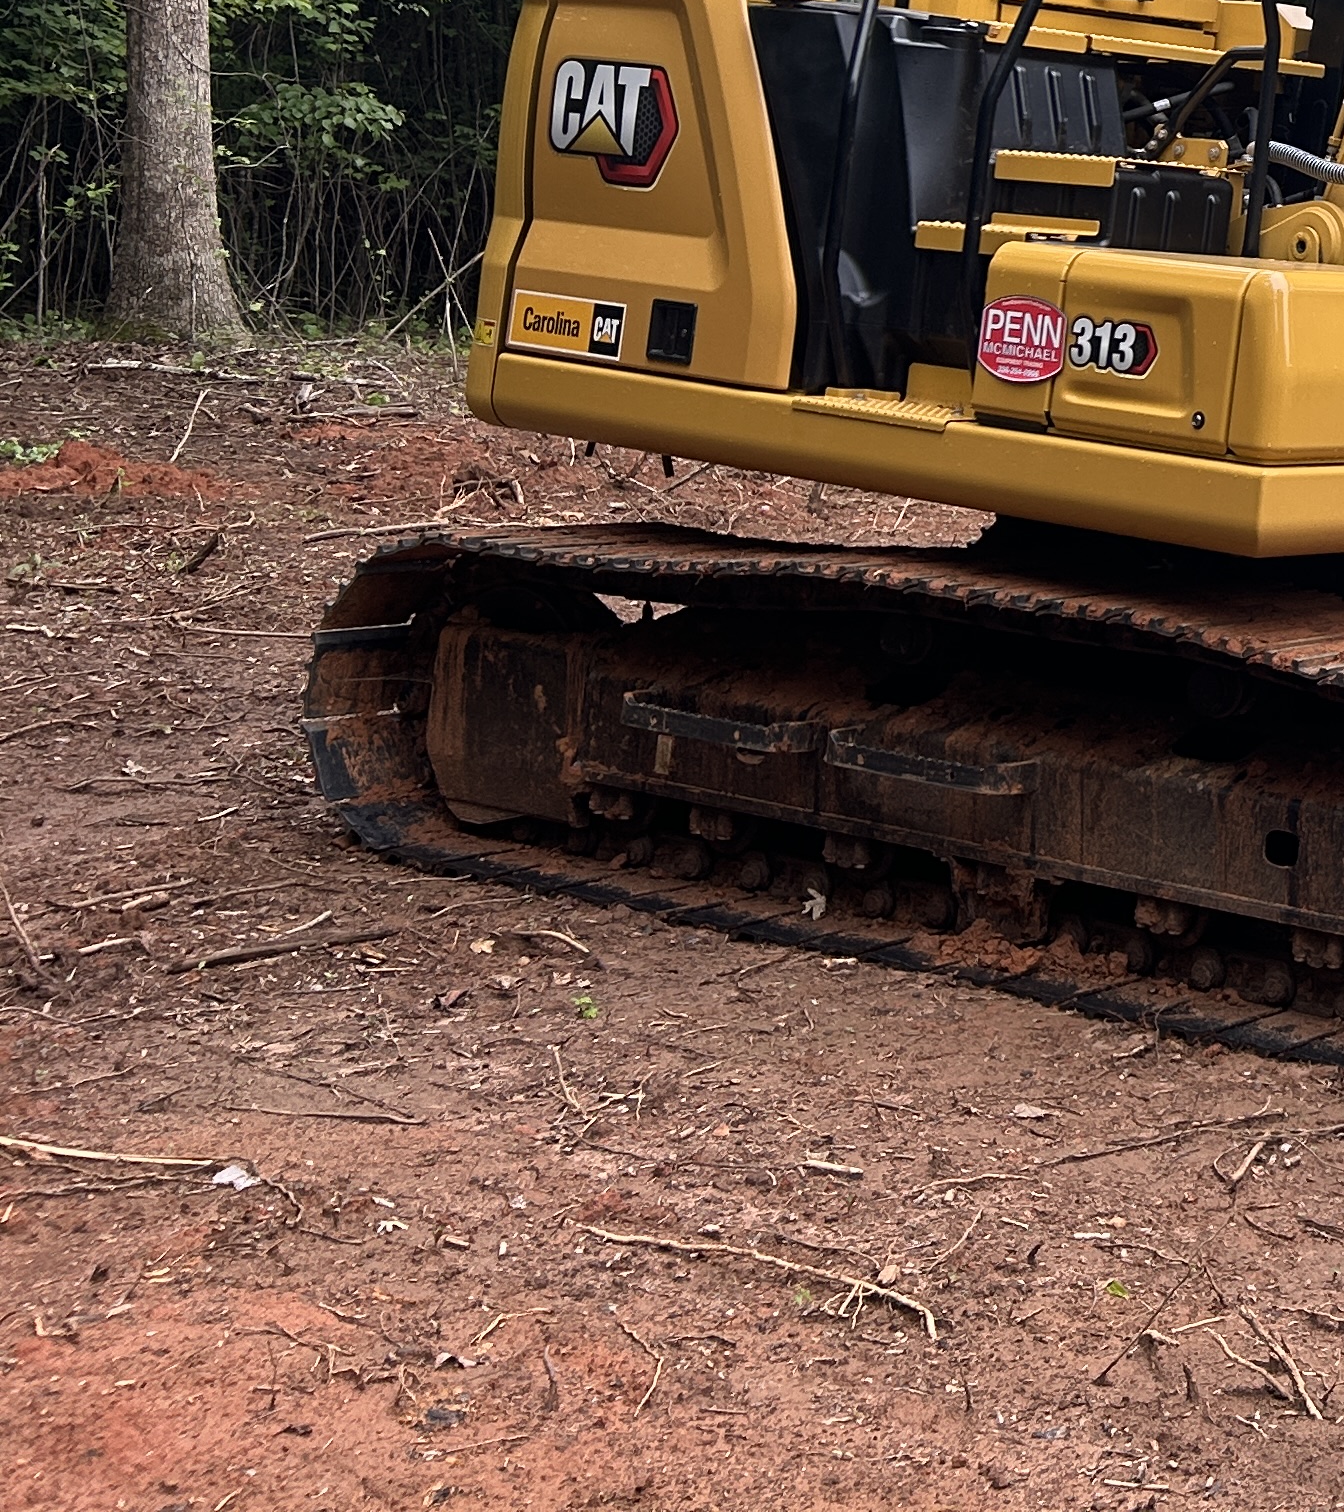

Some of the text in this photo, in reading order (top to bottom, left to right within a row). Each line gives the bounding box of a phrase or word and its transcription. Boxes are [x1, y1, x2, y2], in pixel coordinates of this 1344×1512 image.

[551, 60, 652, 157] CAT
[523, 306, 620, 344] Carolina CAT
[985, 308, 1063, 349] PENN
[1070, 317, 1137, 371] 313
[982, 341, 1059, 362] MCMICHAEL
